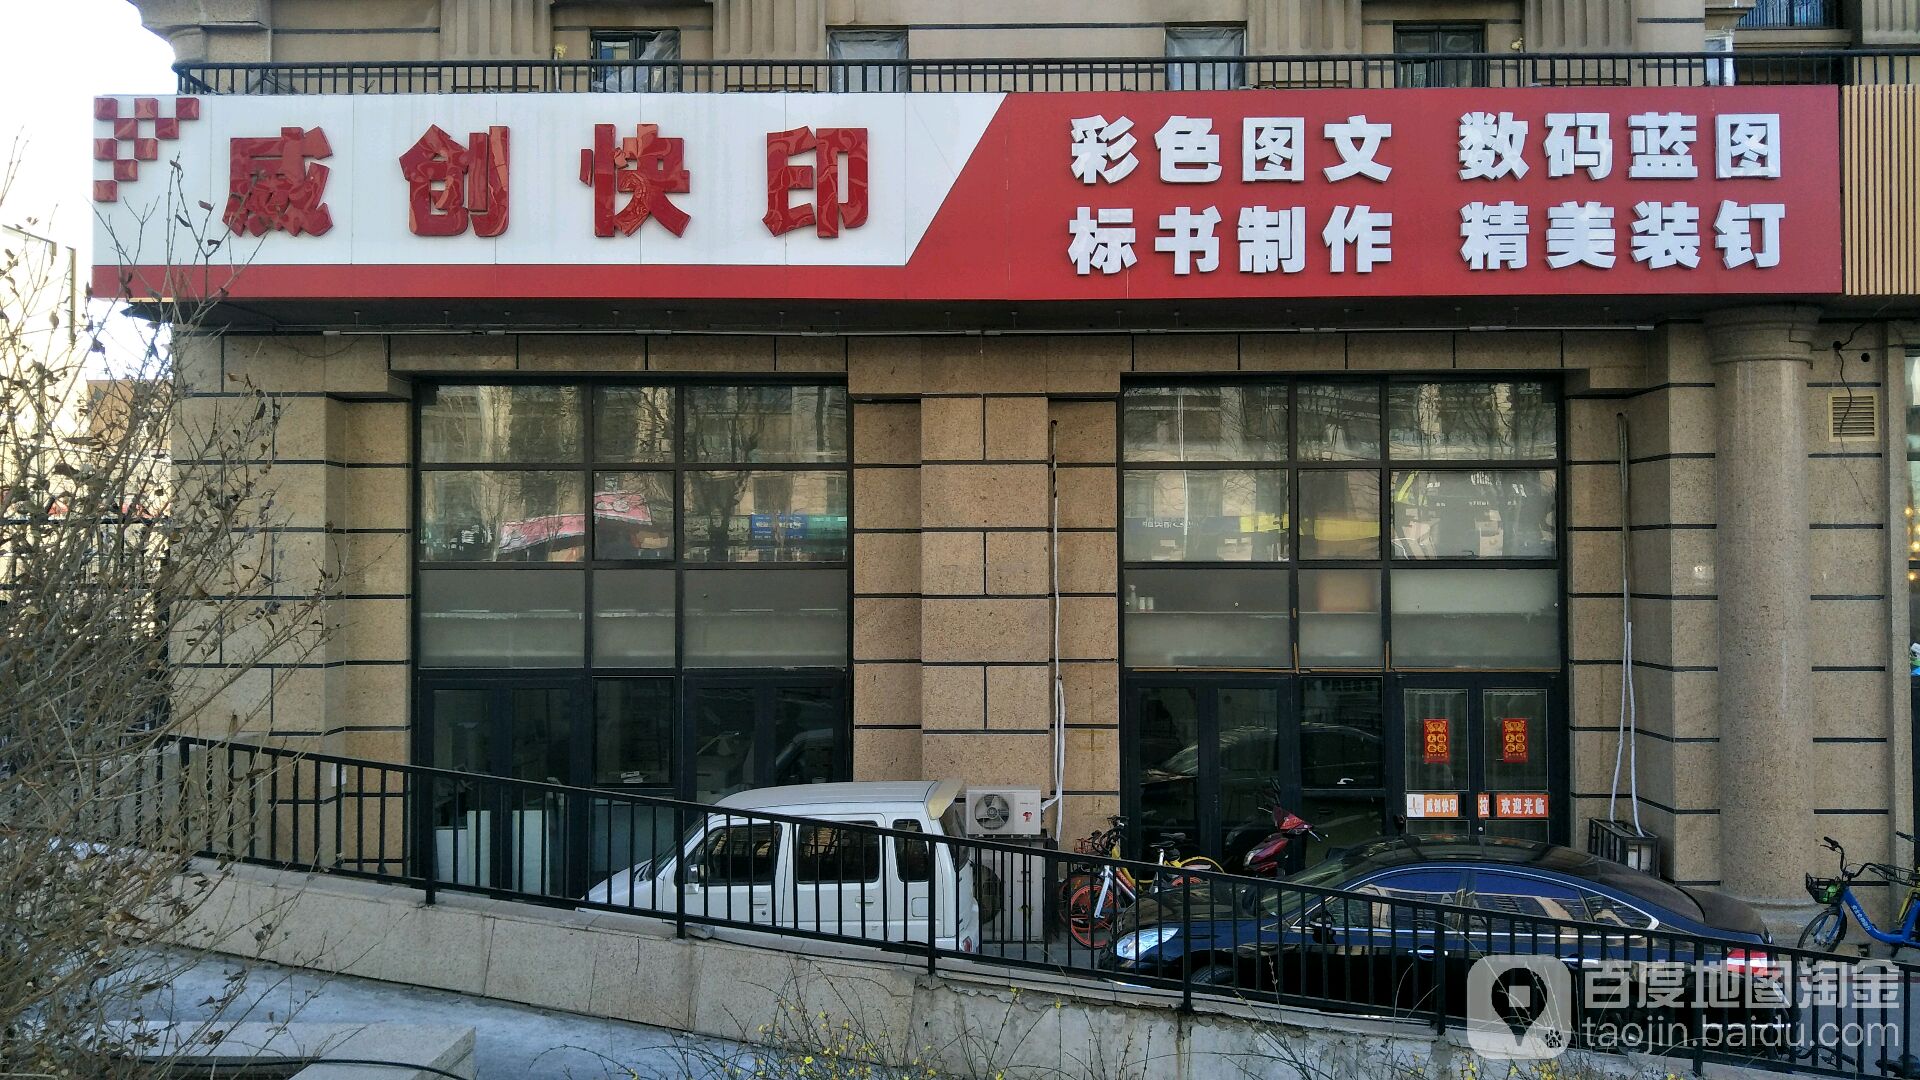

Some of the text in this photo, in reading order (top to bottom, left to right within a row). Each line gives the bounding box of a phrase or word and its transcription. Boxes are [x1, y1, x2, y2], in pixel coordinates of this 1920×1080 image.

[222, 124, 868, 239] 威创快印
[1070, 110, 1783, 185] 彩色图文 数码蓝图
[1068, 199, 1787, 275] 标书制作 精美装钉
[1479, 796, 1489, 815] 拉
[1501, 797, 1545, 815] 欢迎光临
